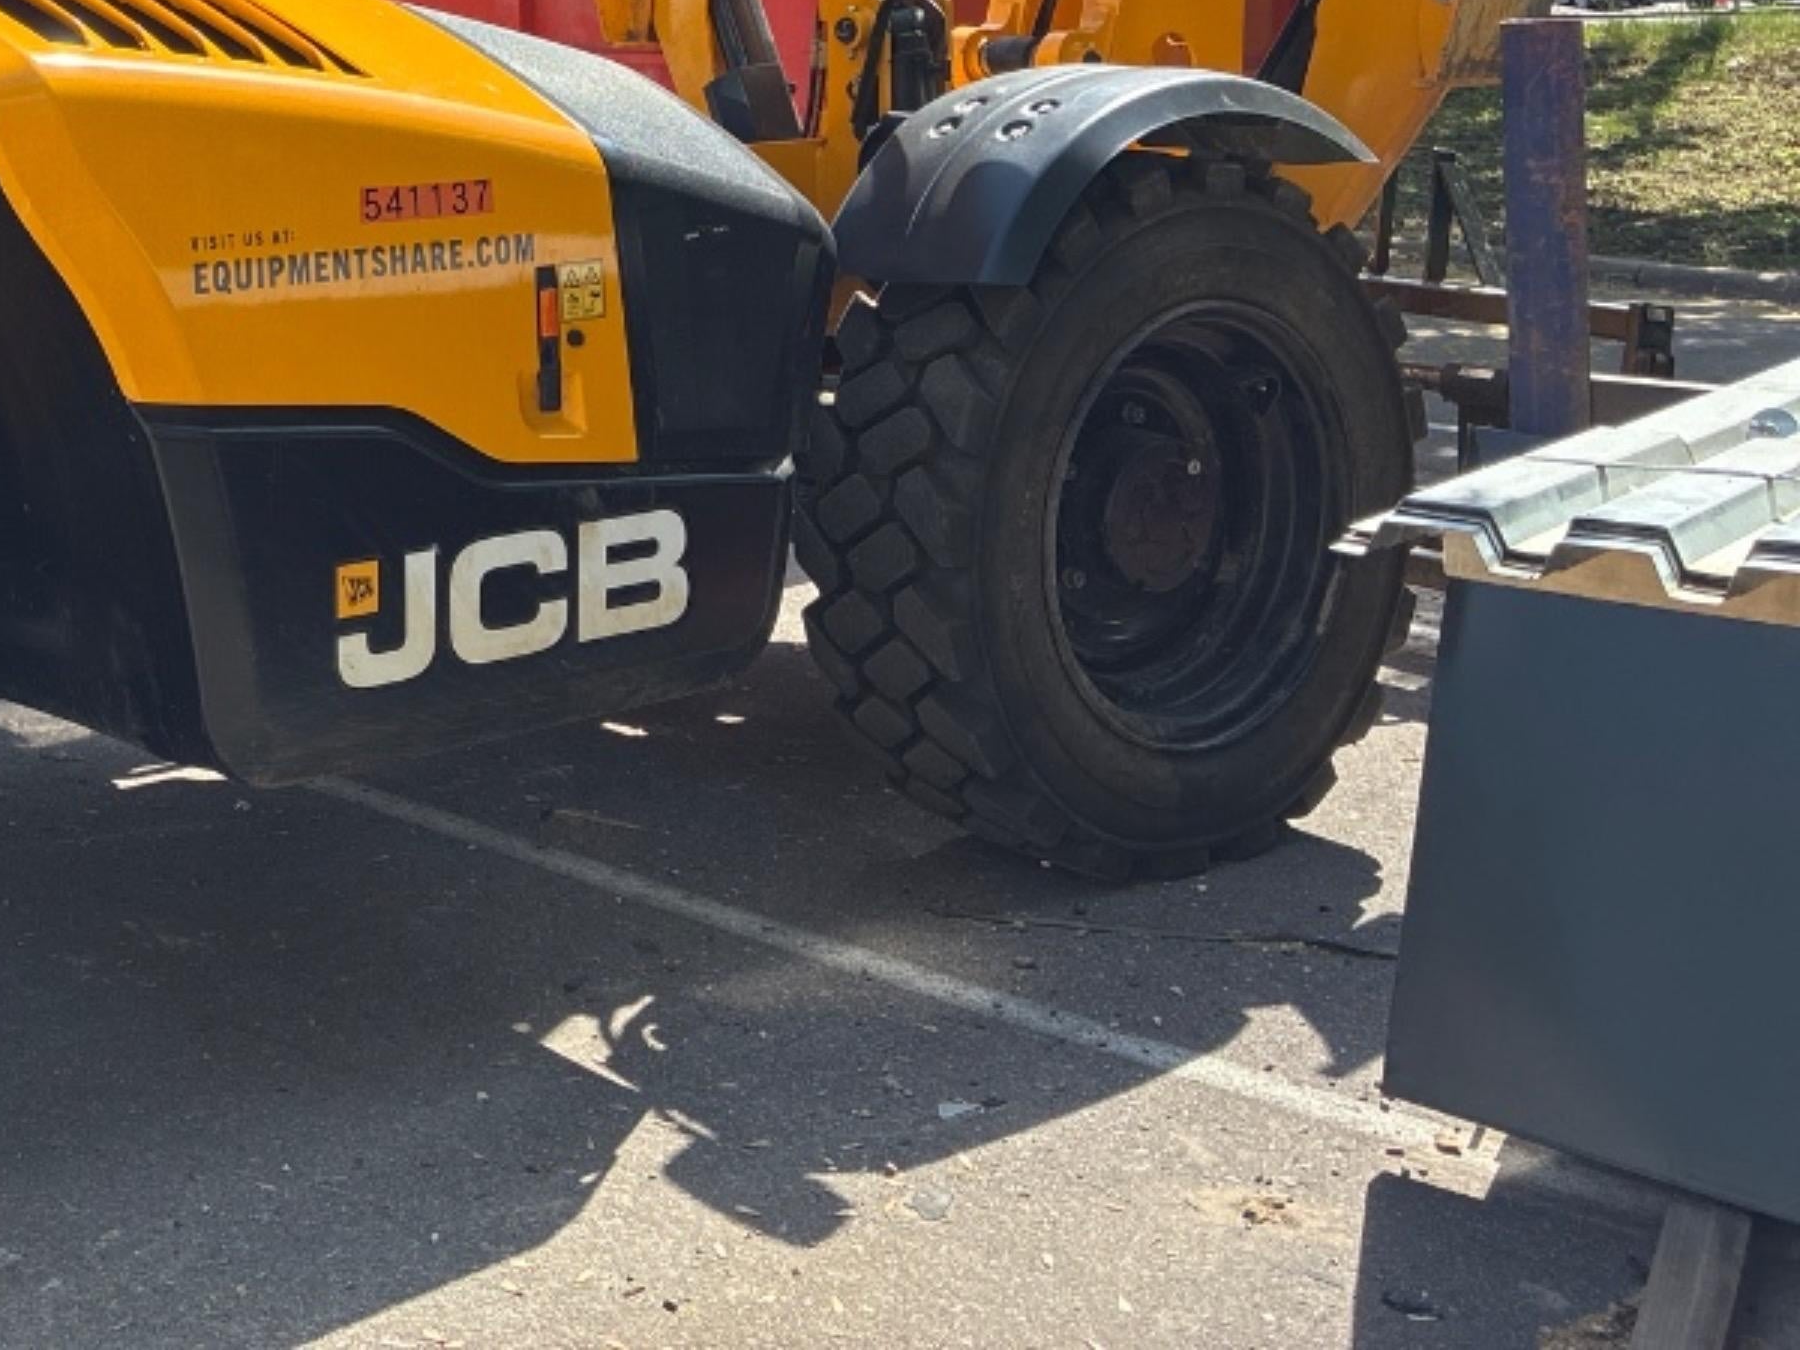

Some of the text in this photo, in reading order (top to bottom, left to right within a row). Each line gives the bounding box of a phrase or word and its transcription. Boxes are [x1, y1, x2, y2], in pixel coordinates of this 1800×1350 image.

[363, 180, 490, 221] 541137
[190, 233, 235, 251] VISIT
[244, 231, 264, 247] US
[193, 233, 536, 295] EQUIPMENTSHARE.COM
[337, 508, 690, 689] JCB
